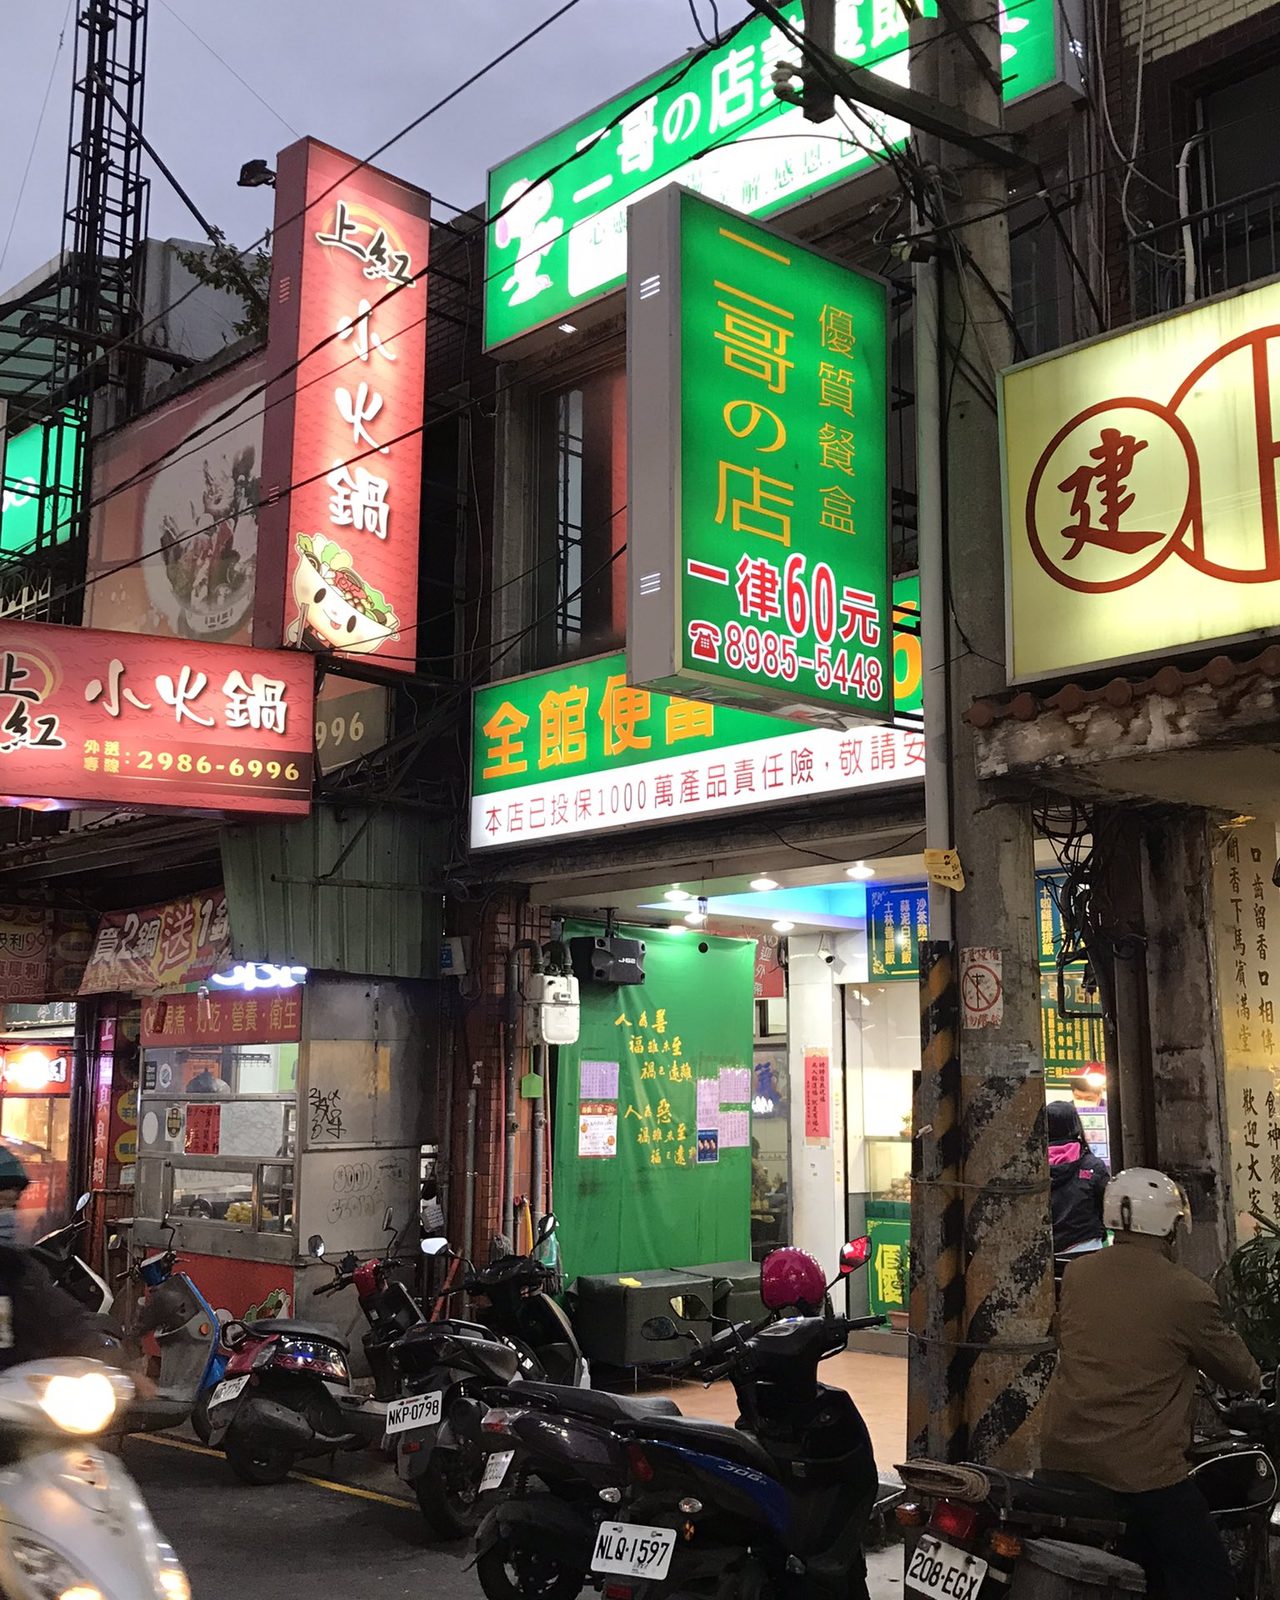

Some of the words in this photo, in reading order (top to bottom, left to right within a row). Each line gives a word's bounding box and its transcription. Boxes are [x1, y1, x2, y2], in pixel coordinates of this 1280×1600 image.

[315, 199, 417, 289] 上紅
[325, 298, 399, 541] 小火鍋
[713, 226, 794, 548] 二哥の店
[817, 302, 857, 536] 優質餐盒
[1057, 427, 1167, 561] 建
[687, 551, 881, 648] 一律60元
[84, 657, 289, 735] 小火鍋
[724, 620, 883, 702] 8985-5448
[315, 711, 364, 750] 996
[916, 897, 928, 942] 沙茶豬
[1250, 845, 1275, 1057] 口齒留香口相傳
